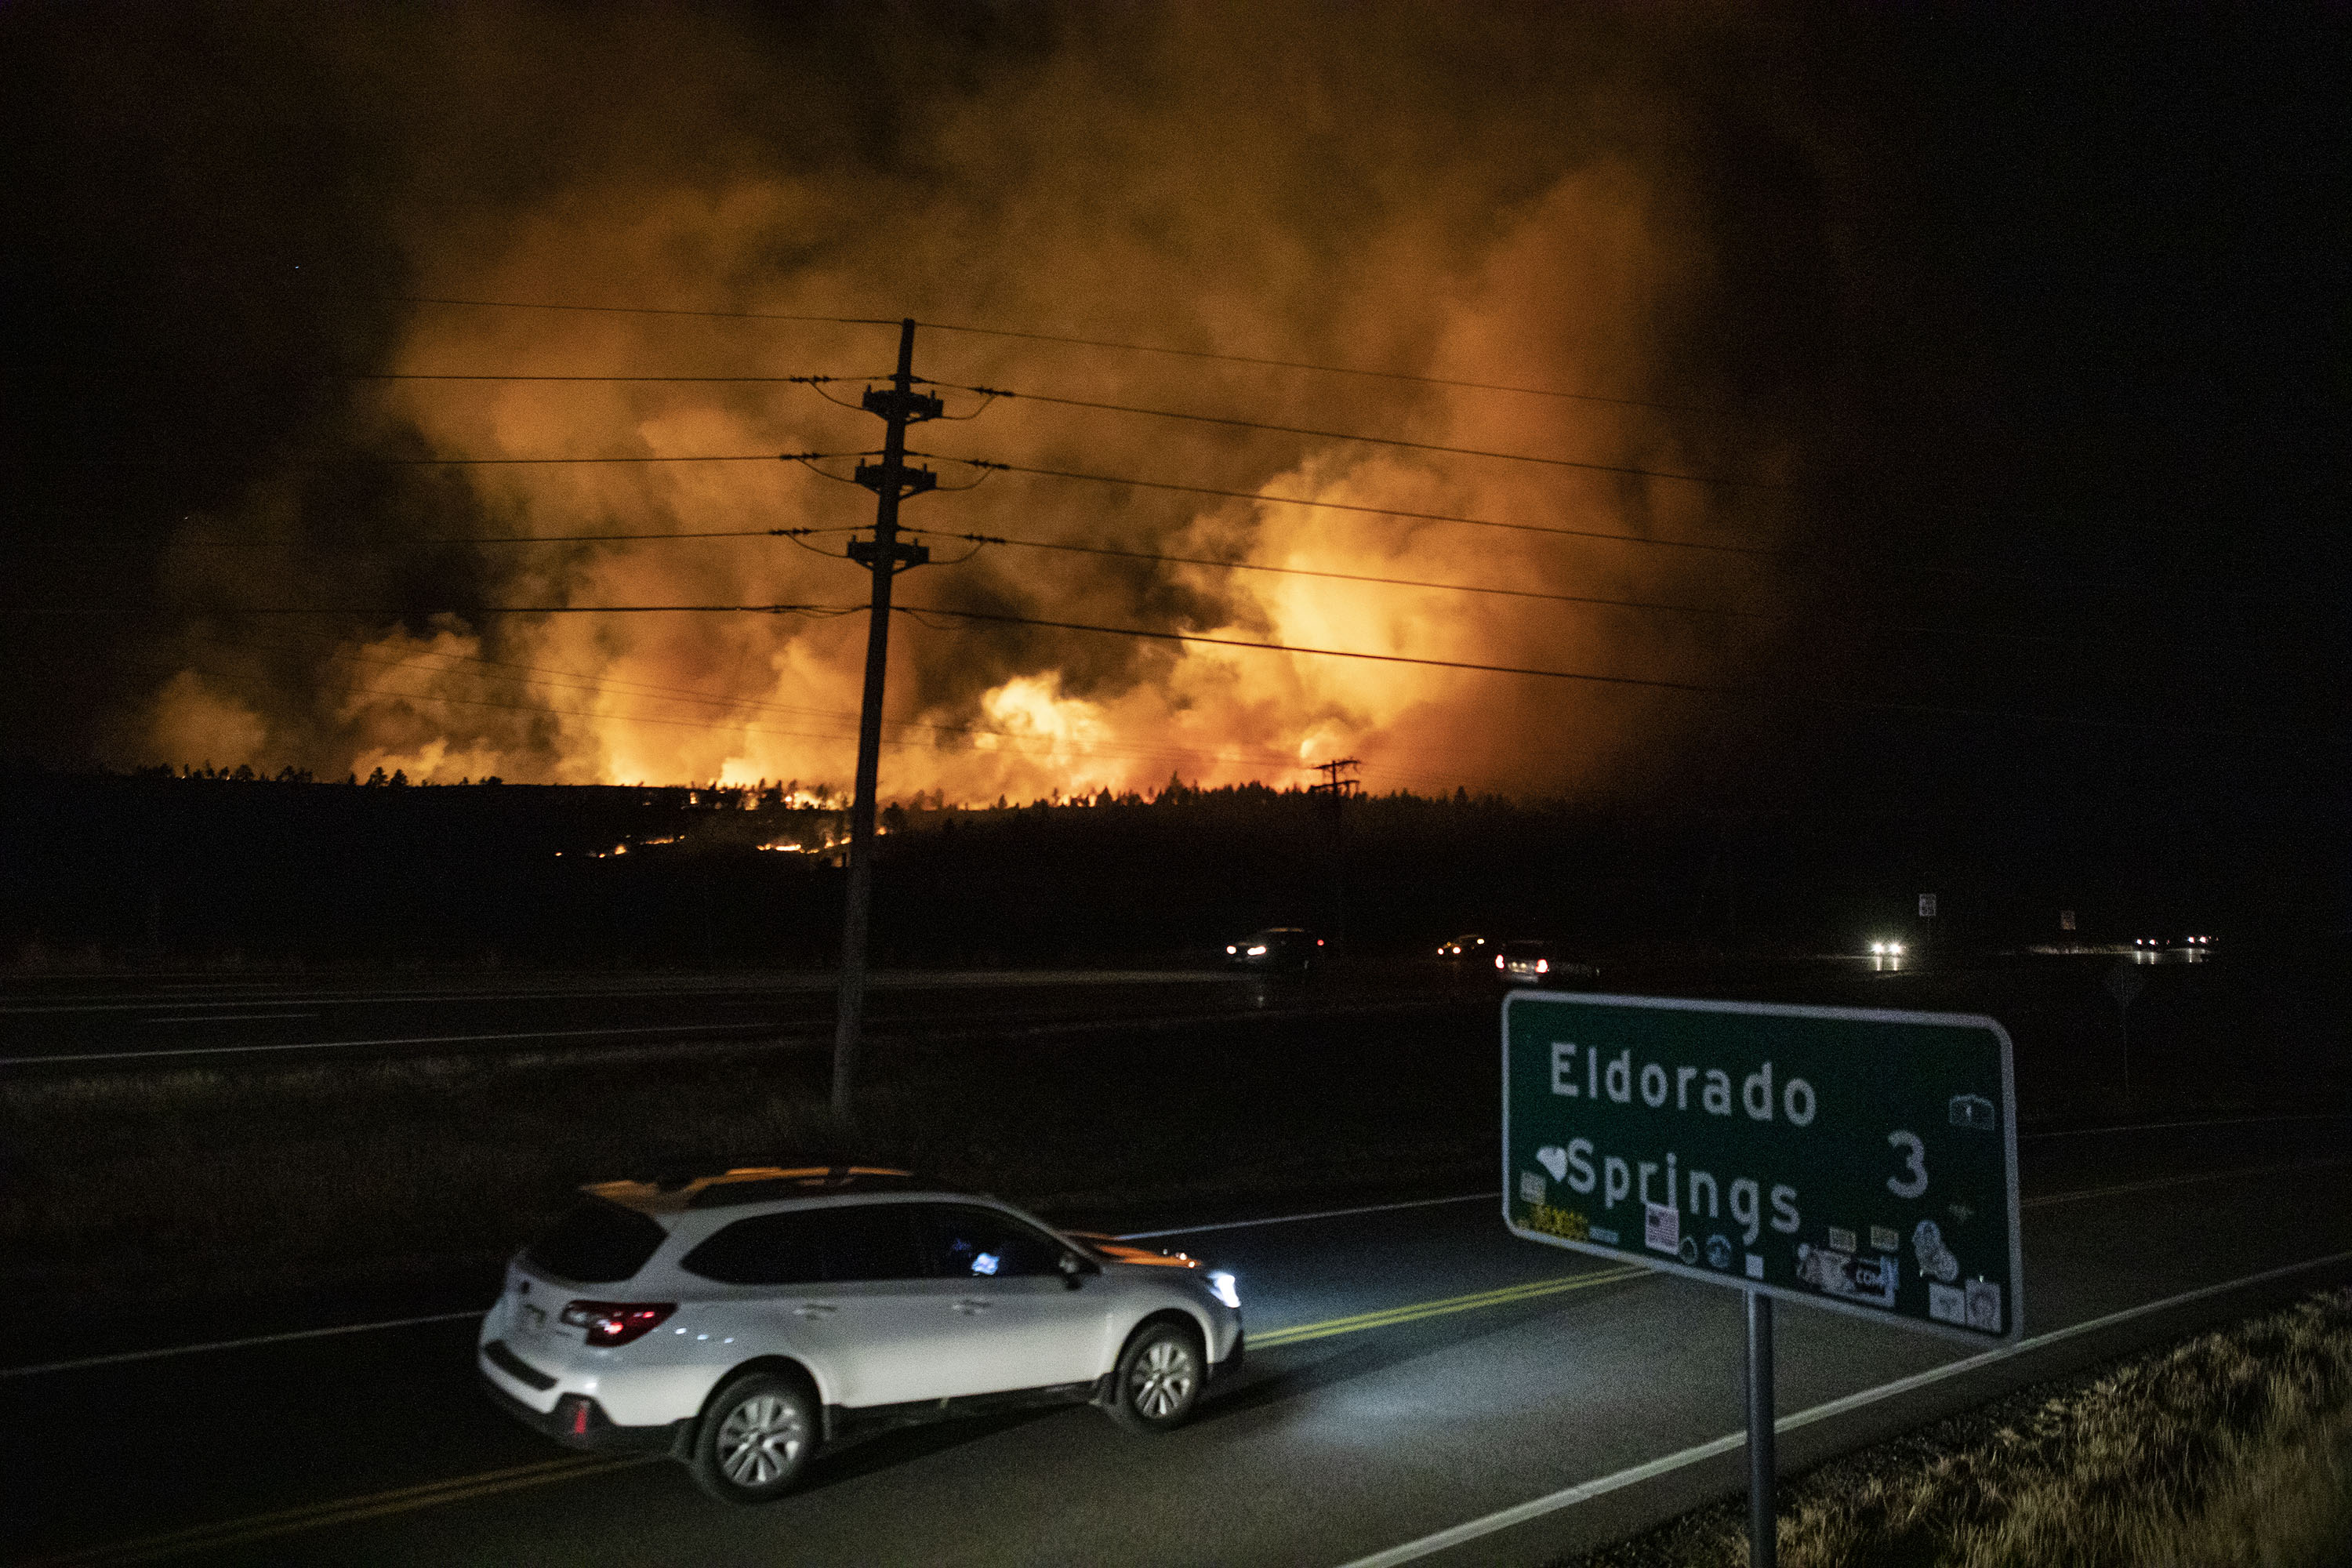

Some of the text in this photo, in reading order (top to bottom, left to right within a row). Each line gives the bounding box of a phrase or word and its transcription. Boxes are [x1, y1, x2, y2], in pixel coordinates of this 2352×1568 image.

[1550, 1041, 1817, 1127] Eldorado
[1568, 1138, 1800, 1245] Springs
[1887, 1130, 1929, 1199] 3
